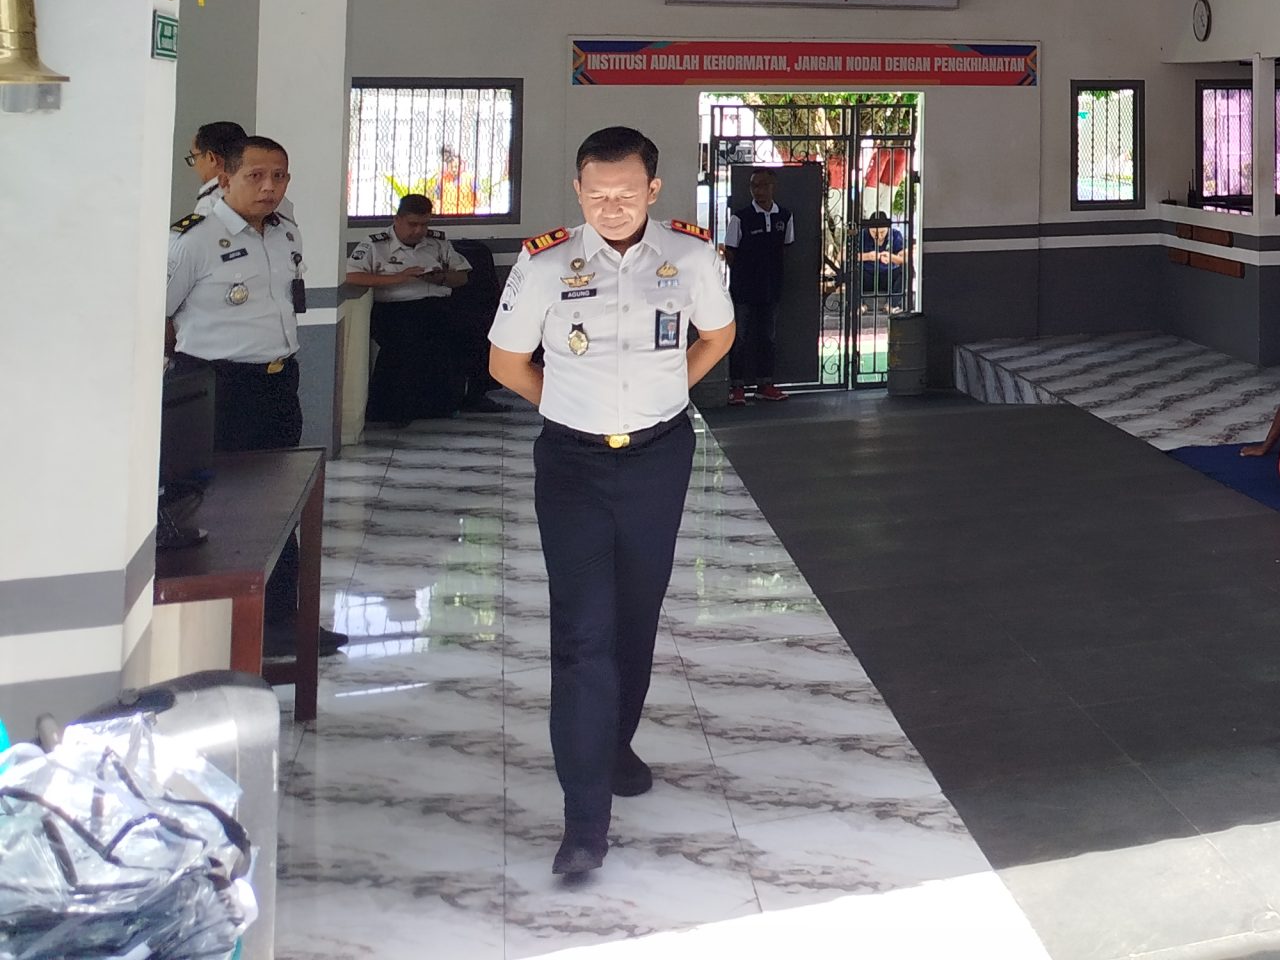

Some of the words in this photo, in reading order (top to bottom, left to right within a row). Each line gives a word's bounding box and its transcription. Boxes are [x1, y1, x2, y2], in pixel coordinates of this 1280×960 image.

[587, 54, 647, 70] INSTITUSI
[650, 55, 700, 71] ADALAH
[703, 55, 791, 72] KEHORMATAN,
[794, 55, 843, 71] JANGAN
[846, 56, 882, 72] NODAI
[885, 56, 931, 72] DENGAN
[934, 57, 1025, 72] PENGKHIANATAN
[567, 290, 590, 298] AGUNG
